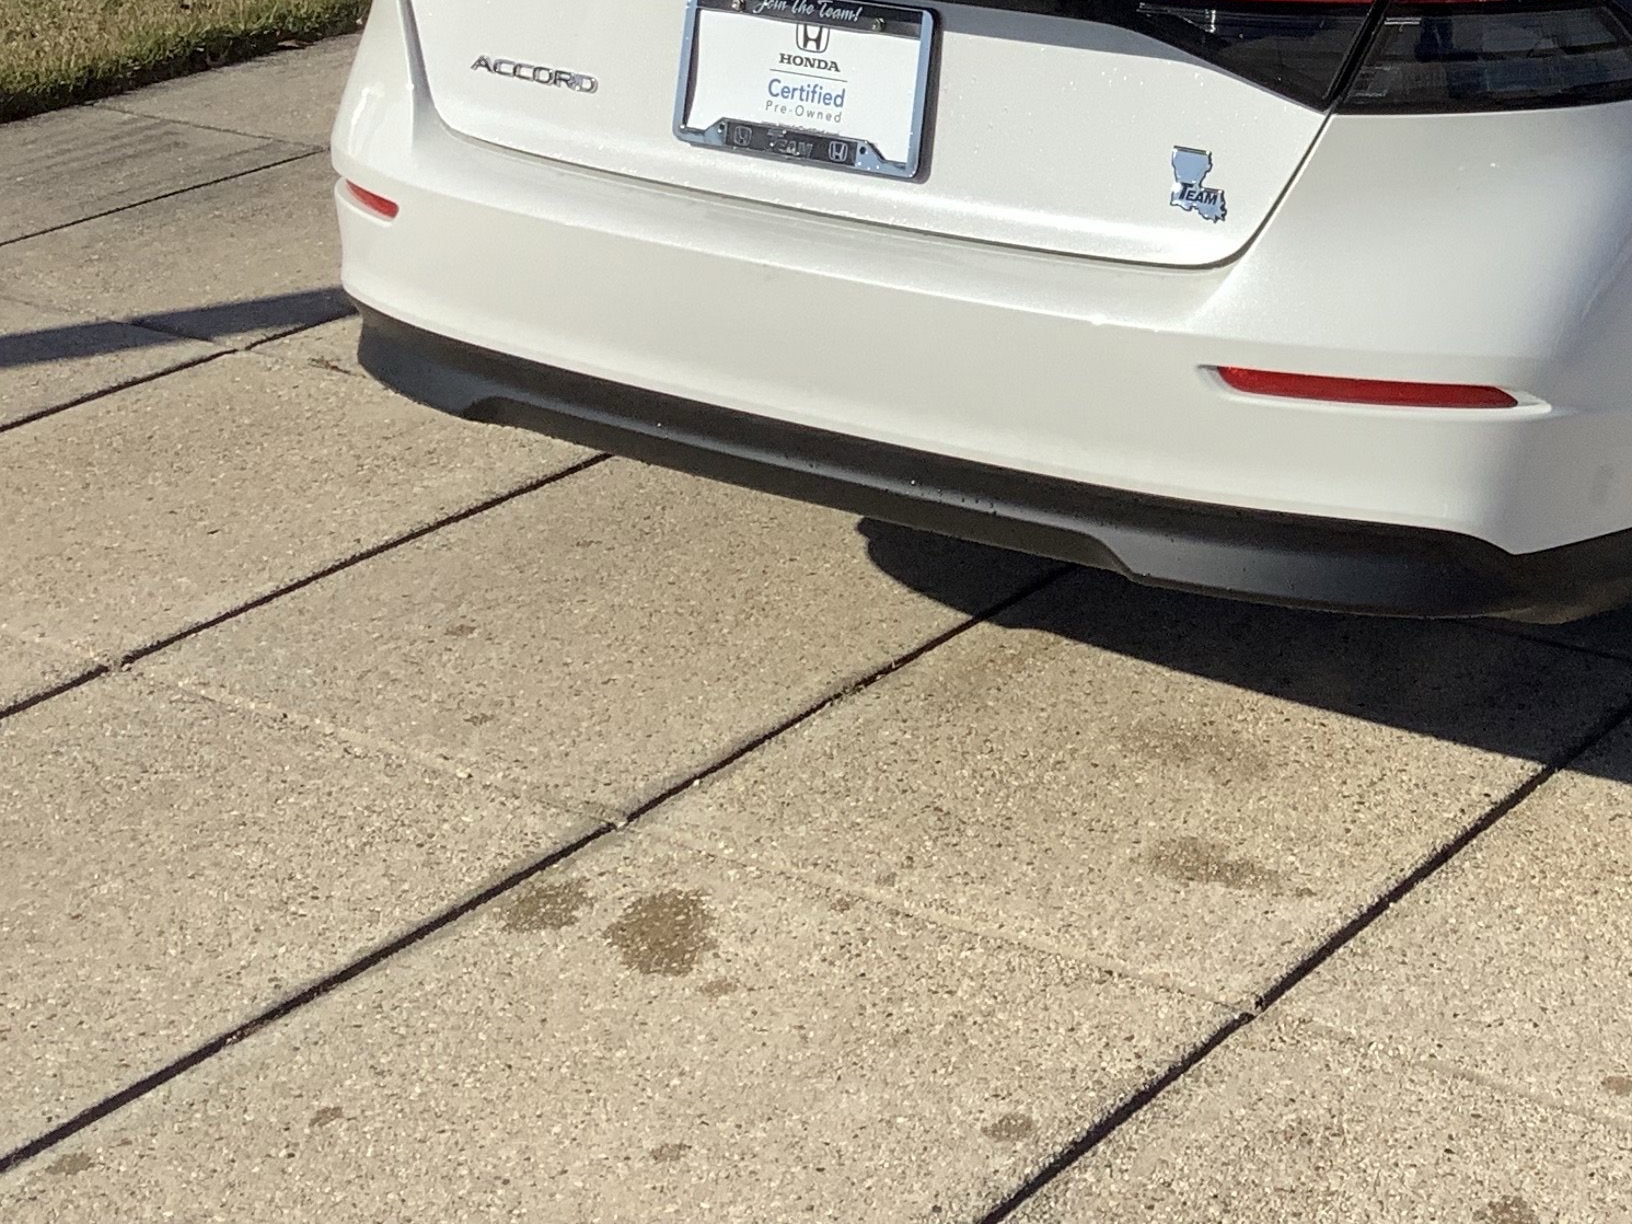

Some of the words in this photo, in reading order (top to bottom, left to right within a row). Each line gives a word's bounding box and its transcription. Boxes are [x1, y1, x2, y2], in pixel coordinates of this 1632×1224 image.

[816, 0, 864, 23] Team!
[469, 54, 600, 95] ACCORD
[778, 52, 841, 73] HONDA
[766, 78, 846, 109] Certified
[764, 100, 843, 124] Pre-Owned
